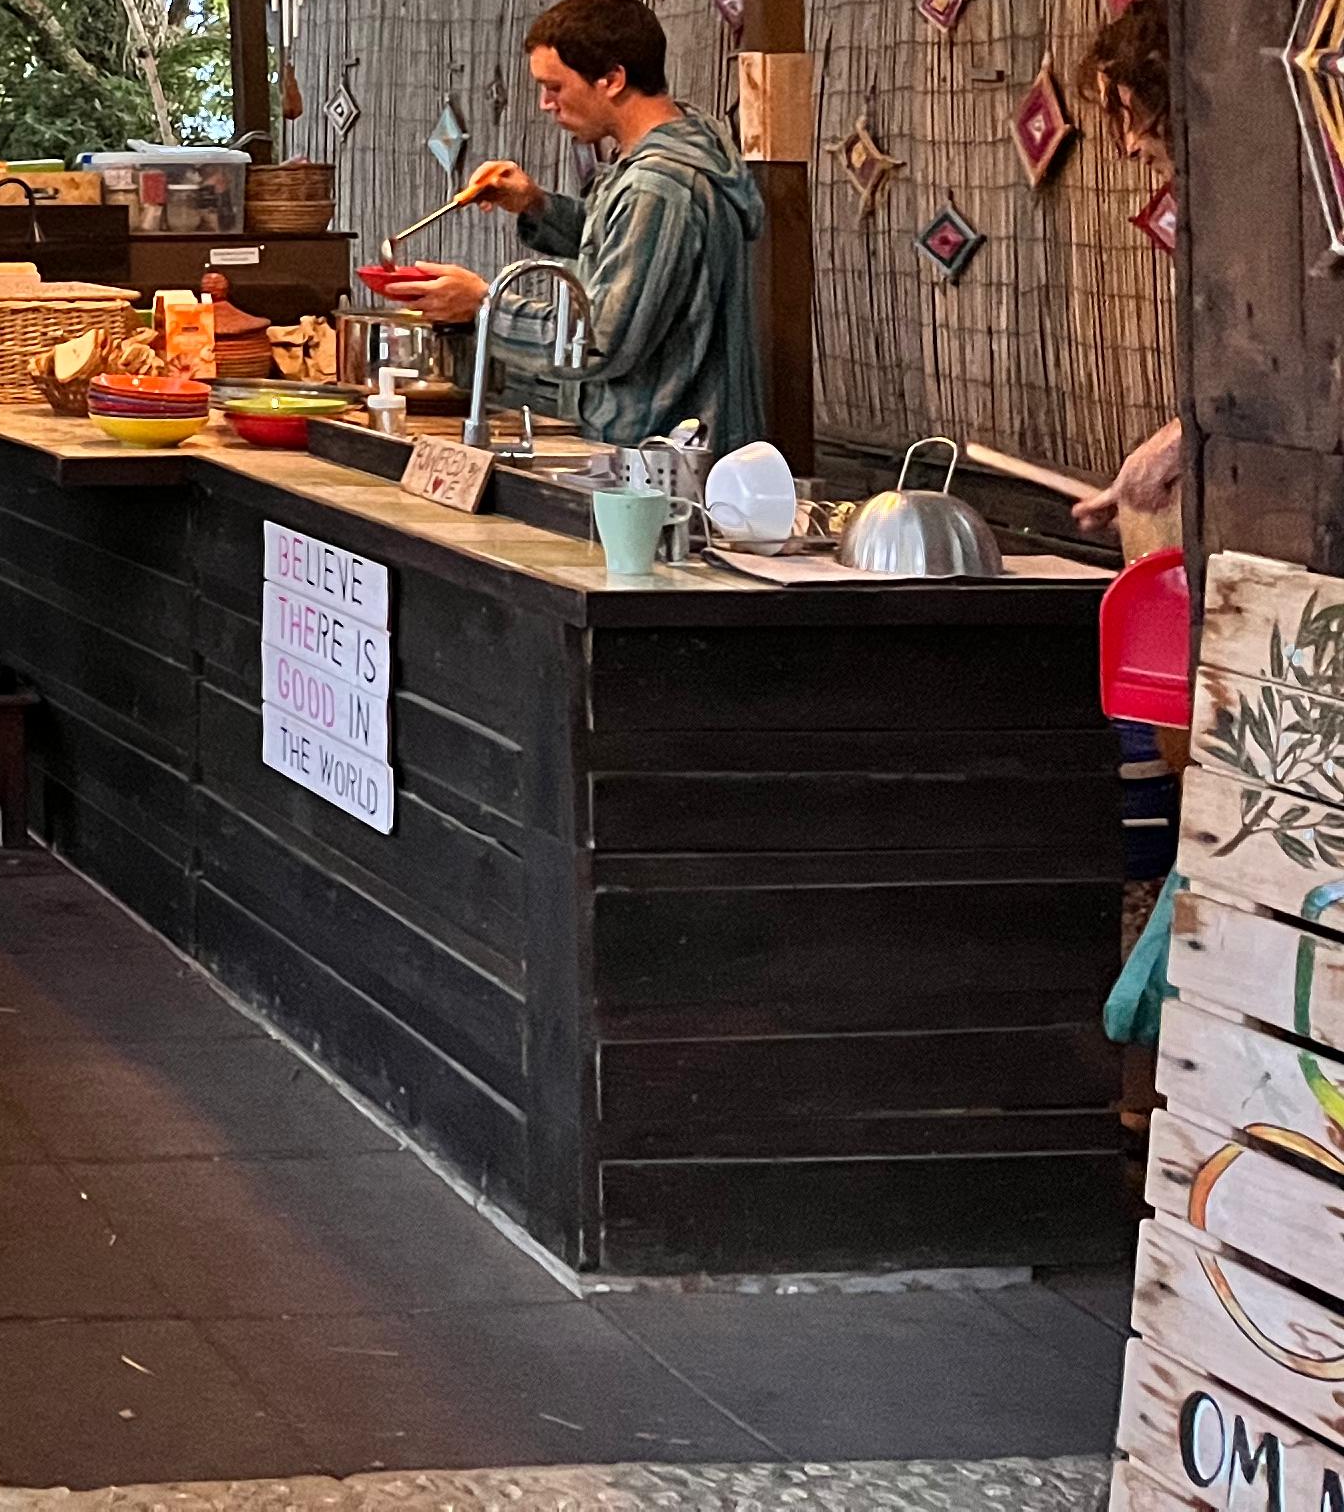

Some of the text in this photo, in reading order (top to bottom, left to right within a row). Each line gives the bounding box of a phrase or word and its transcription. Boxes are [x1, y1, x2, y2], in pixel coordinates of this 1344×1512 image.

[278, 535, 364, 606] BELIEVE
[278, 595, 376, 684] THERE IS
[277, 658, 370, 746] GOOD IN
[280, 726, 379, 816] THE WORLD
